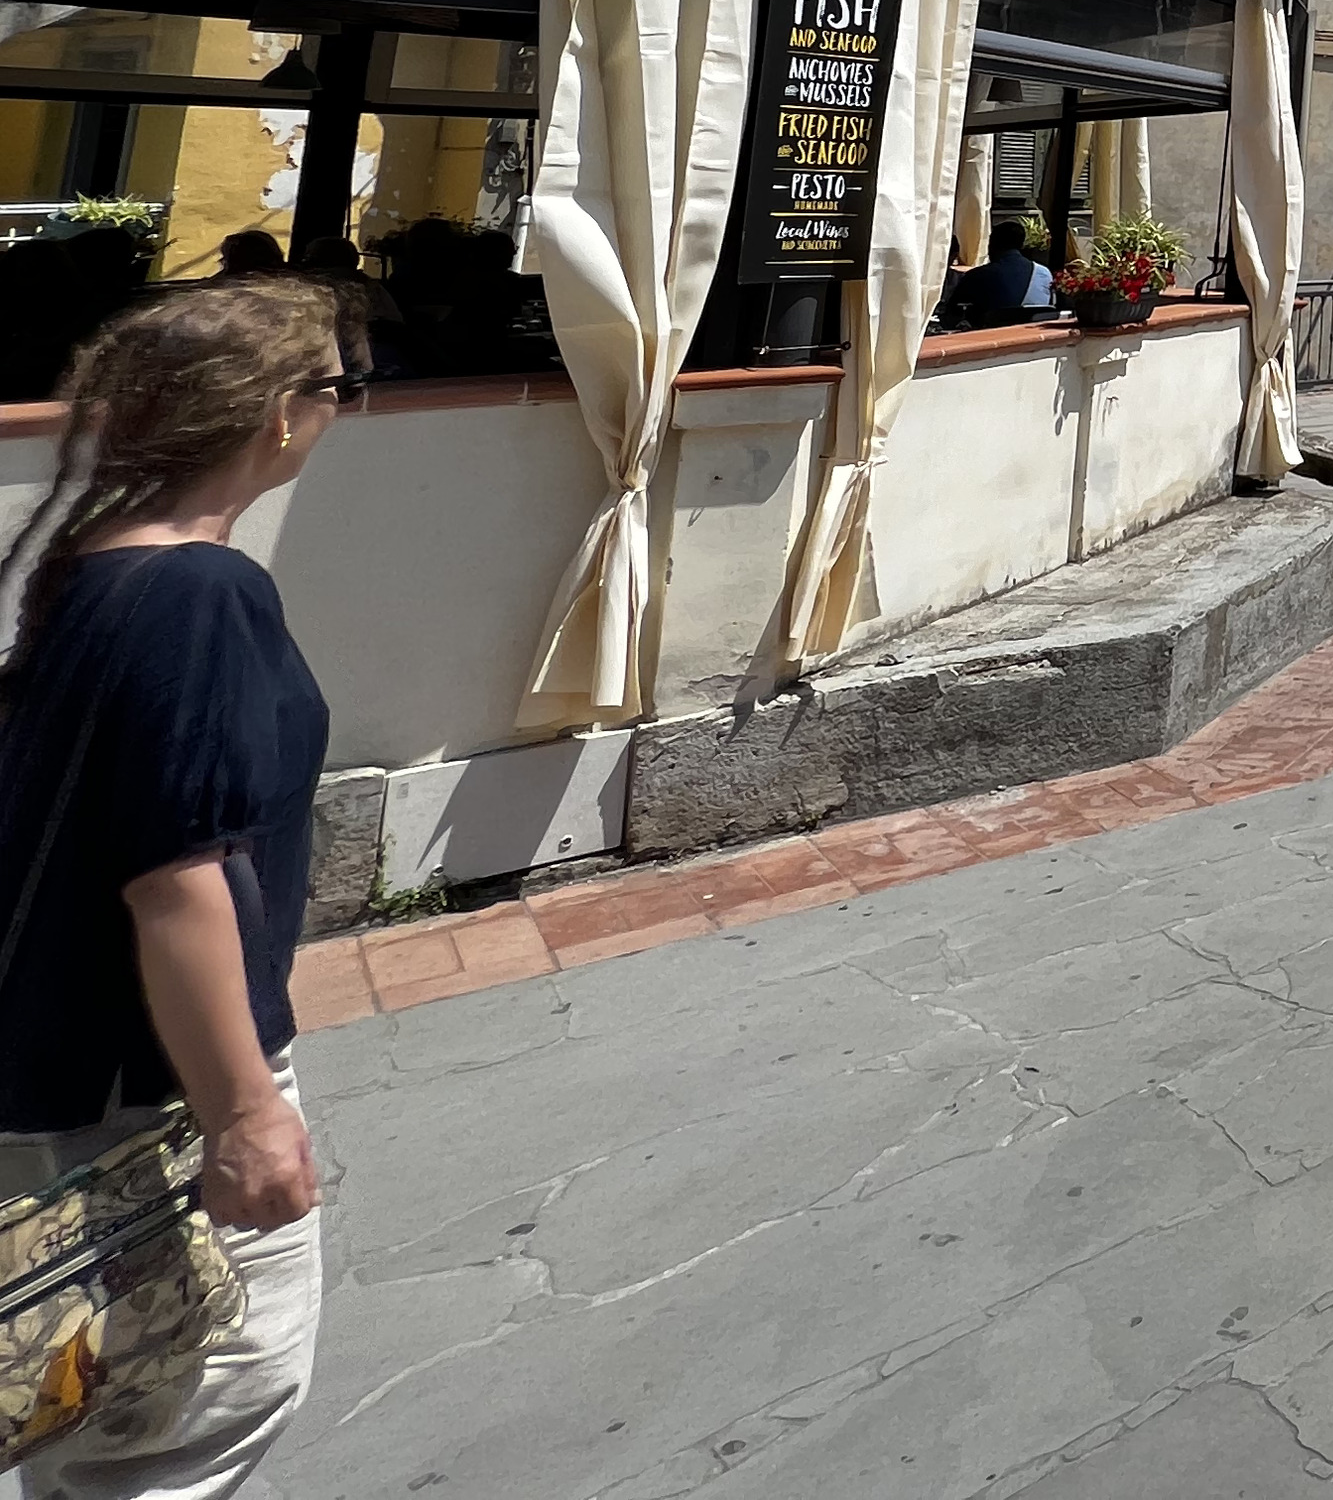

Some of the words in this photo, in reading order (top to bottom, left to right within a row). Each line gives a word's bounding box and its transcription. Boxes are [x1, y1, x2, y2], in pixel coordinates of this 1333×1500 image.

[789, 27, 817, 47] AND
[820, 30, 877, 53] SEAFOOD
[789, 57, 874, 85] ANCHOVIES
[800, 82, 871, 107] MUSSELS
[778, 112, 828, 138] FRIED
[832, 115, 873, 141] FISH
[794, 140, 868, 166] SEAFOOD
[791, 173, 846, 200] PESTO
[775, 220, 812, 239] Local
[813, 220, 850, 239] Wines
